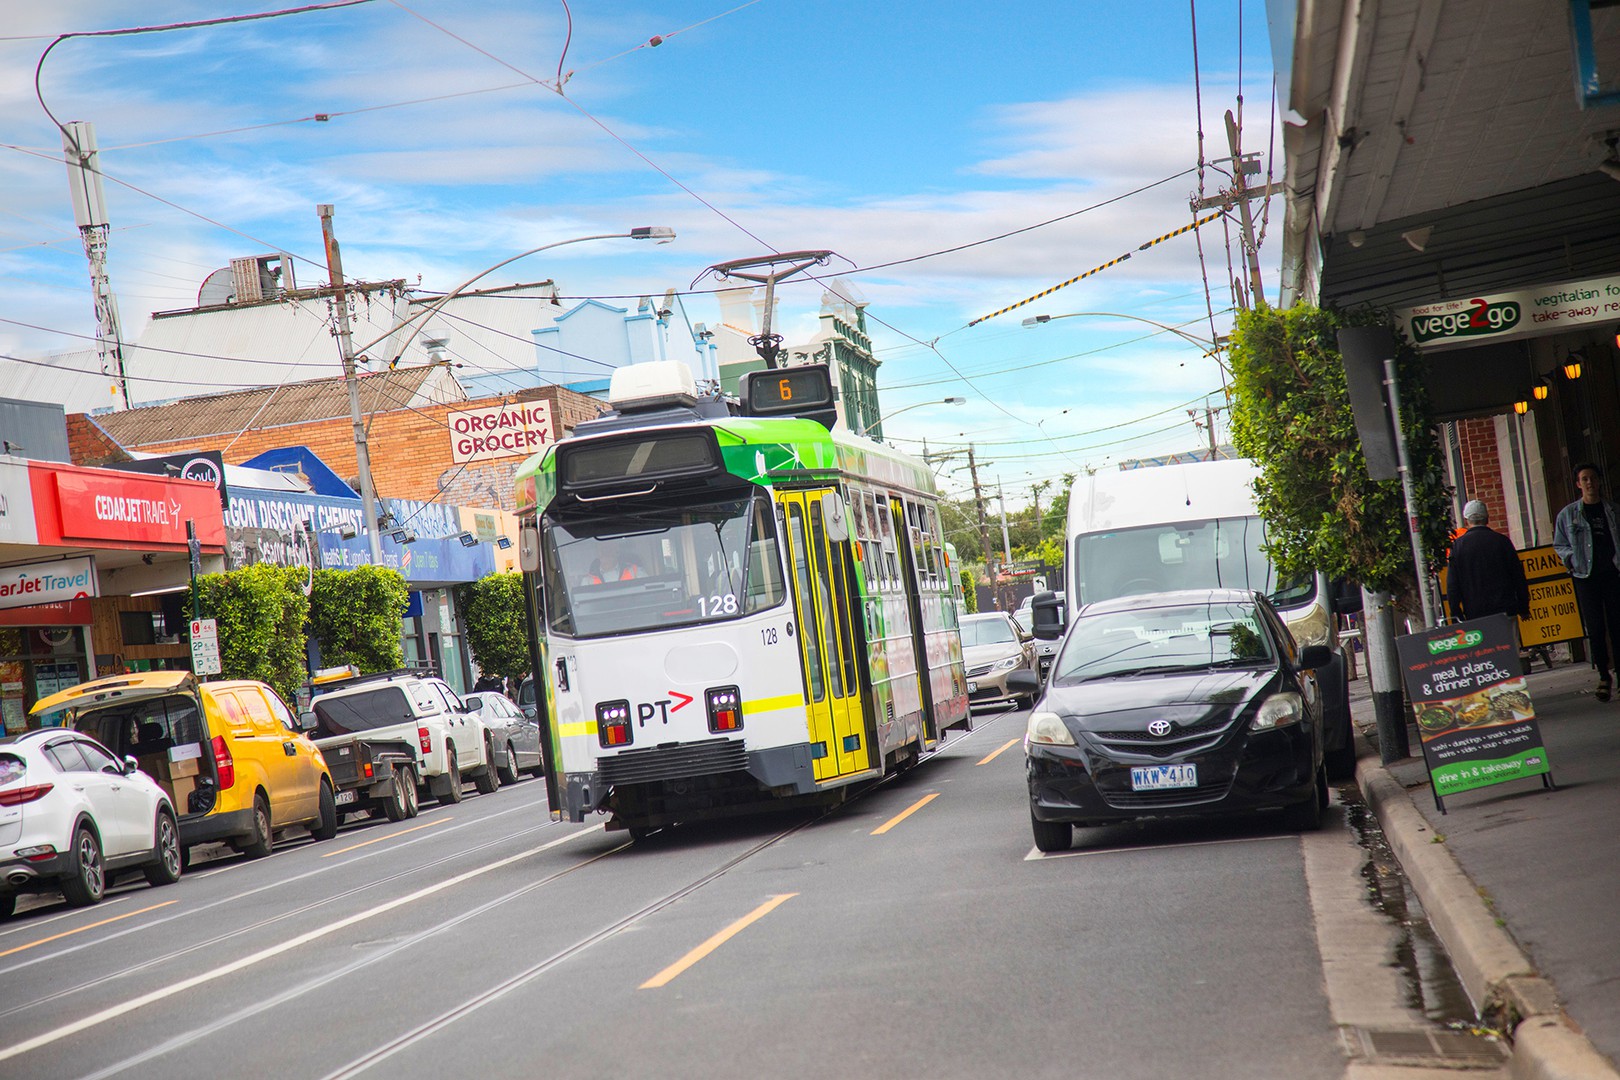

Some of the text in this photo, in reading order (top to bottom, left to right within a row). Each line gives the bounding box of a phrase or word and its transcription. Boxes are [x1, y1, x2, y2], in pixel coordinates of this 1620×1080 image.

[1534, 286, 1600, 307] vegitalian
[1412, 306, 1430, 316] food
[1432, 304, 1445, 314] for
[1413, 298, 1517, 336] vege2go
[1531, 304, 1600, 324] take-away
[778, 378, 793, 402] 6
[454, 406, 547, 436] ORGANIC
[457, 427, 549, 457] GROCERY
[141, 500, 170, 525] TRAVEL
[258, 500, 316, 532] DISCOUNT
[43, 570, 89, 591] Travel
[698, 593, 739, 617] 128
[1551, 602, 1577, 617] YOUR
[761, 628, 778, 645] 128
[1430, 629, 1481, 651] vege2go
[1540, 624, 1562, 639] STEP
[193, 641, 203, 651] 2P
[196, 659, 204, 669] 1P
[1432, 660, 1495, 683] meal plans
[1423, 668, 1511, 696] & dinner packs
[637, 700, 672, 727] PT
[1133, 768, 1194, 785] WKW 410
[1438, 773, 1459, 784] dine
[1461, 769, 1471, 779] in
[1472, 767, 1480, 777] &
[1481, 759, 1523, 776] takeaway
